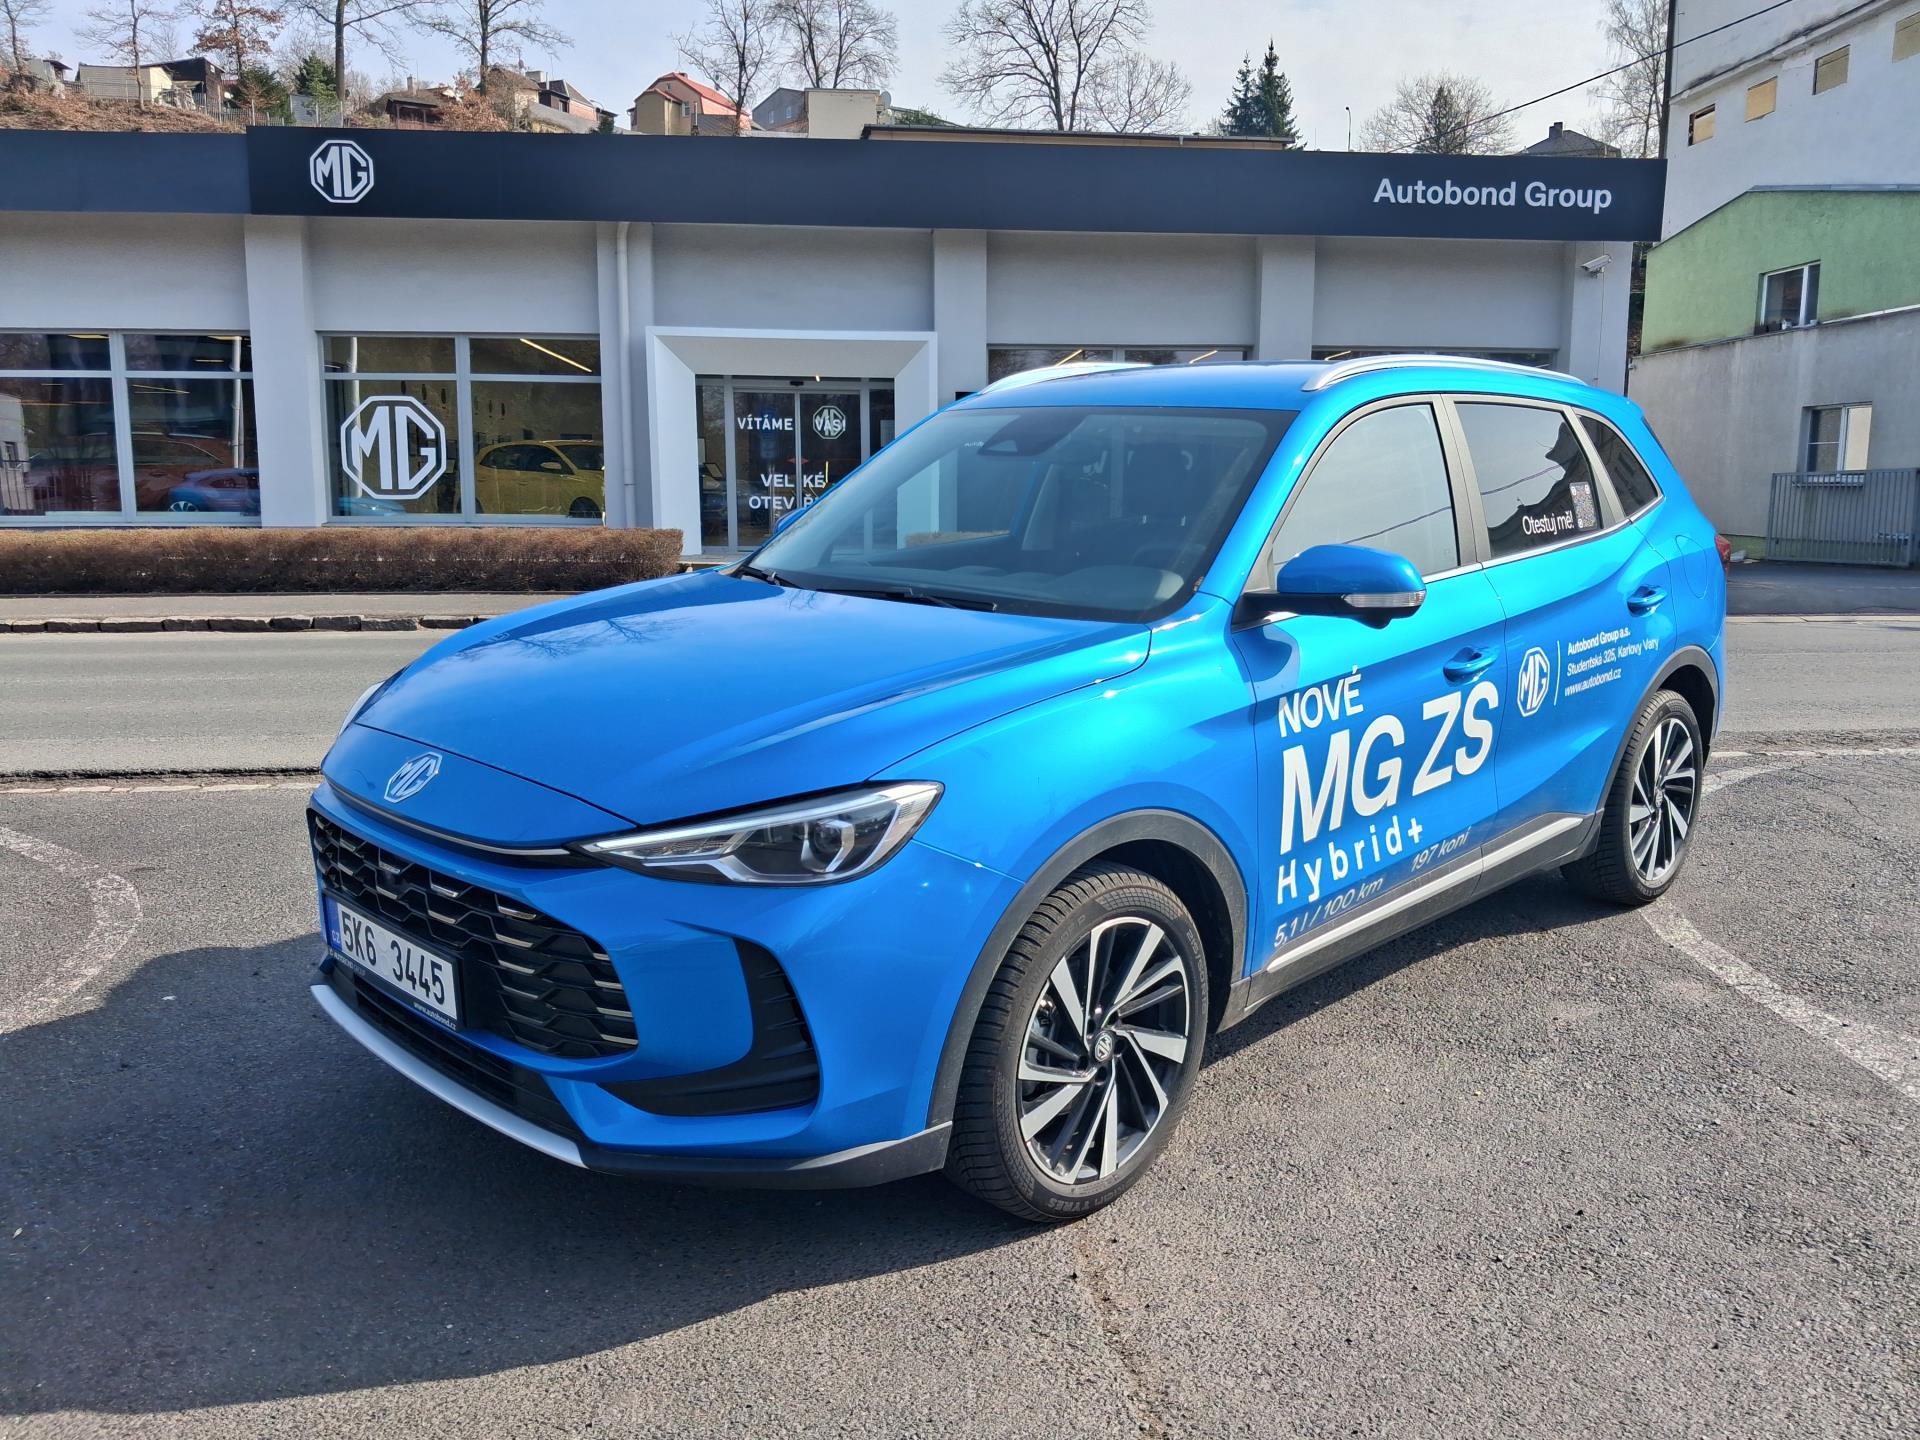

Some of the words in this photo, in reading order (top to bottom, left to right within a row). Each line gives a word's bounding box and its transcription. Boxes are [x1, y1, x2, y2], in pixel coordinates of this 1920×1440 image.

[314, 144, 369, 199] MG
[1373, 178, 1516, 206] Autobond
[1524, 181, 1612, 214] Group
[350, 404, 437, 491] MG
[737, 414, 793, 431] VÍTÁME
[1522, 513, 1557, 535] Otestuj
[1557, 510, 1575, 529] mě!
[1567, 654, 1602, 676] Studentská
[1618, 641, 1642, 659] Karlovy
[1643, 638, 1659, 652] Vary
[1568, 634, 1599, 655] Autobond
[1599, 630, 1619, 646] Group
[1619, 627, 1631, 638] a.s.
[1278, 665, 1364, 738] NOVÉ
[1519, 652, 1548, 712] MG
[1565, 668, 1622, 696] www.autobond.cz
[1280, 714, 1405, 855] MG
[1412, 681, 1499, 797] ZS
[1274, 915, 1301, 948] 5,1
[1323, 888, 1356, 919] 100
[1357, 876, 1384, 902] km
[1411, 844, 1438, 872] 197
[1437, 826, 1472, 858] koní
[1277, 815, 1423, 904] Hybrid+
[341, 910, 377, 966] 5K6
[390, 940, 445, 1005] 3445
